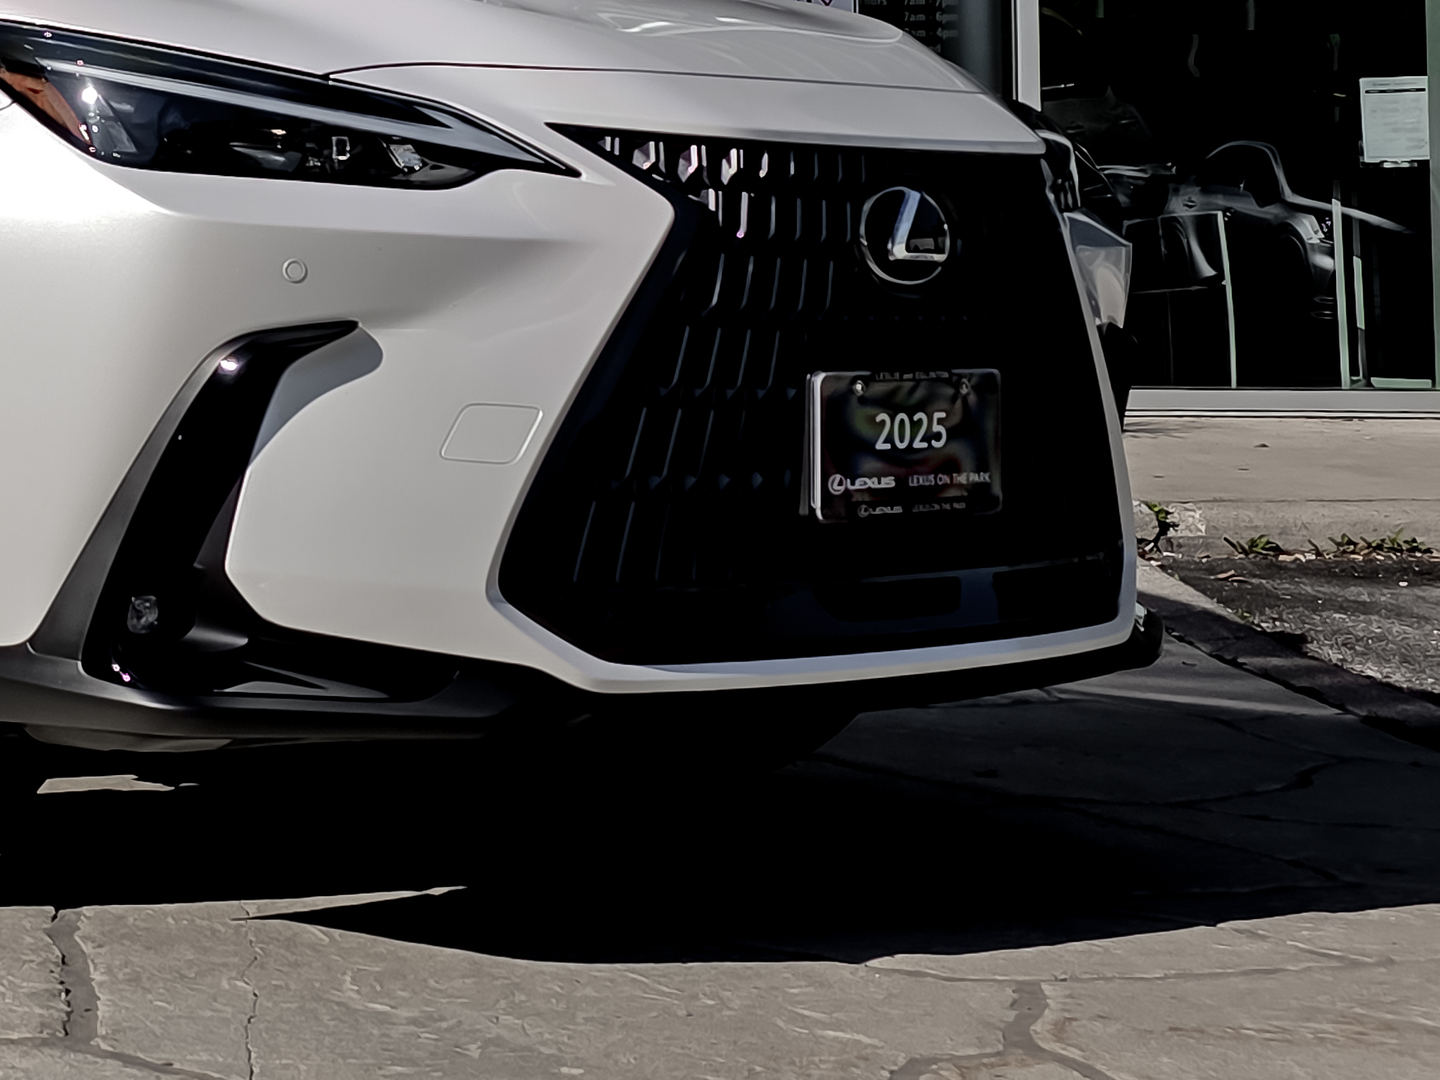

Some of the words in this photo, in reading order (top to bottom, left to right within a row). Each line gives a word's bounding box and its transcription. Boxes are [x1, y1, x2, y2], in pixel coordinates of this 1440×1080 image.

[903, 11, 926, 22] 7am
[875, 411, 948, 450] 2025
[846, 475, 896, 490] LEXUS
[936, 472, 951, 486] ON
[969, 471, 991, 483] PARK
